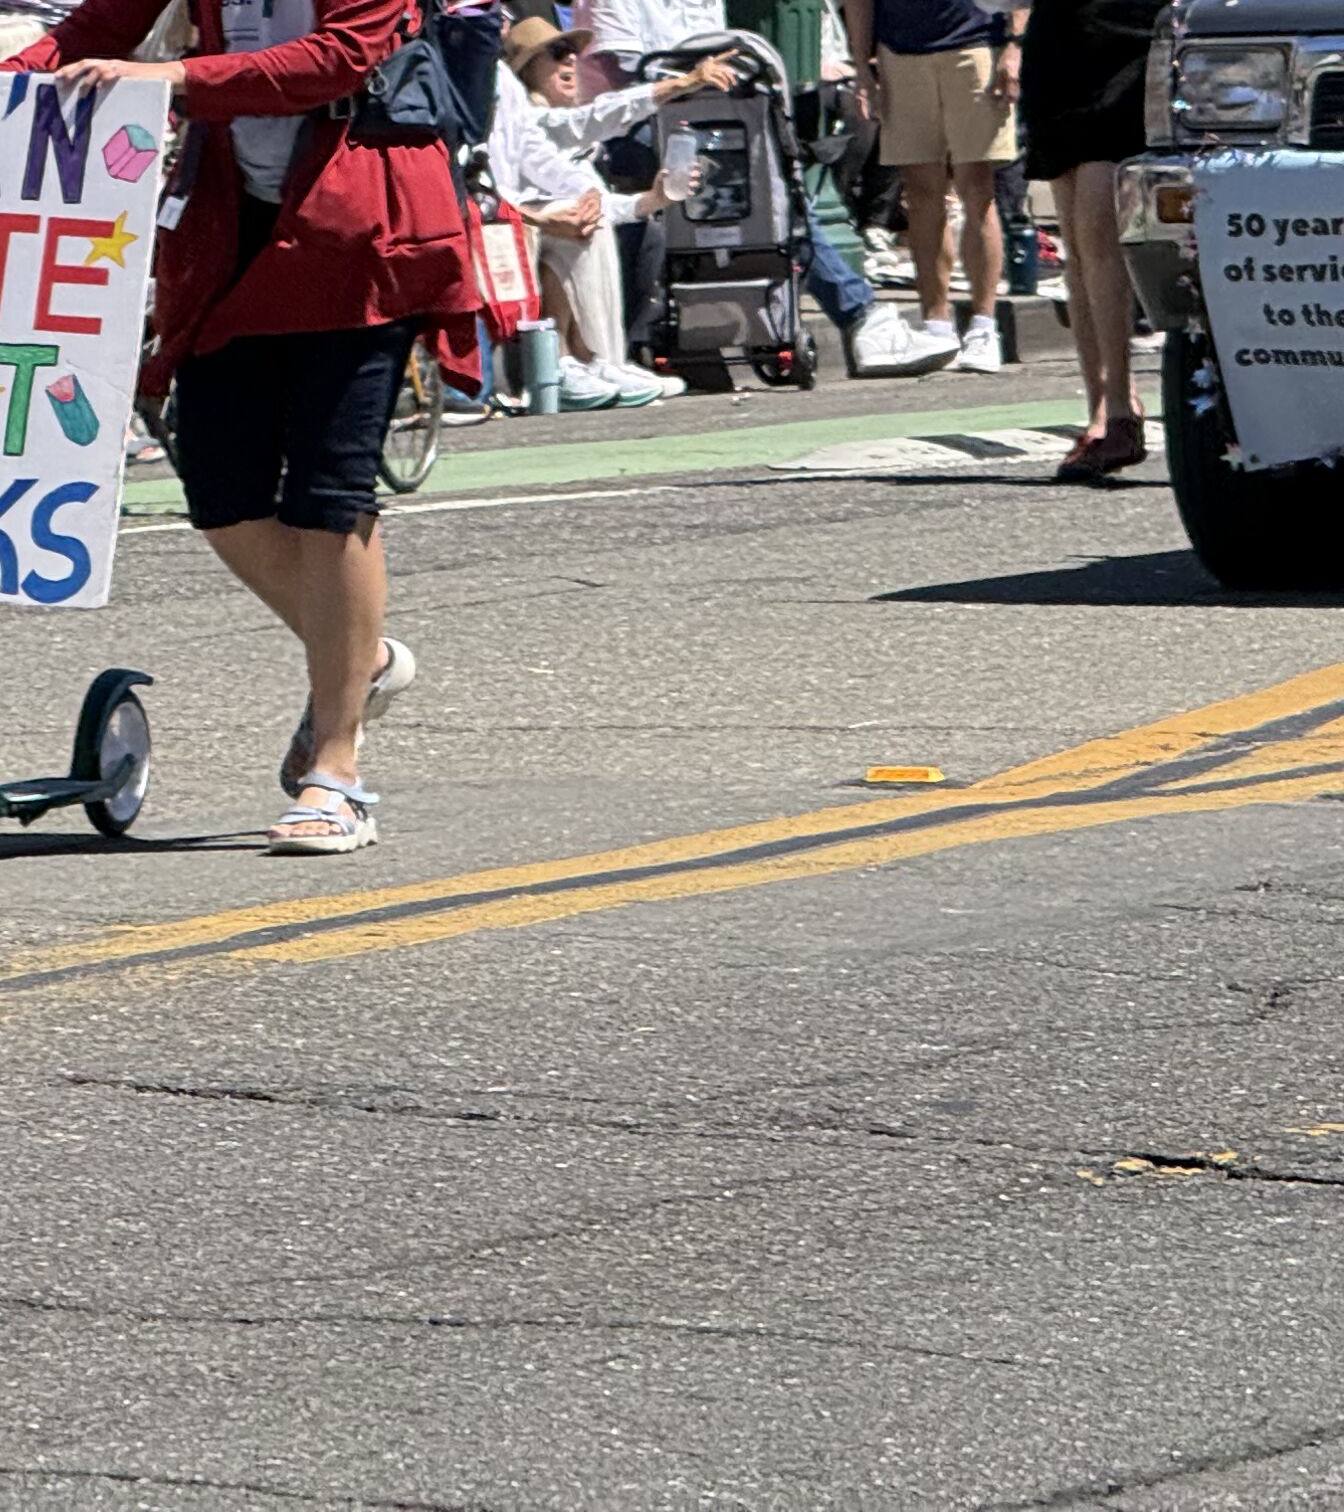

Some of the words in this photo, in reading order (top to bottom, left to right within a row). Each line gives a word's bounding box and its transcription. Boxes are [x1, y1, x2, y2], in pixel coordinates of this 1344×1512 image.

[1227, 212, 1267, 238] 50
[1223, 255, 1255, 283] of
[1262, 254, 1344, 283] servi
[1263, 303, 1296, 326] to
